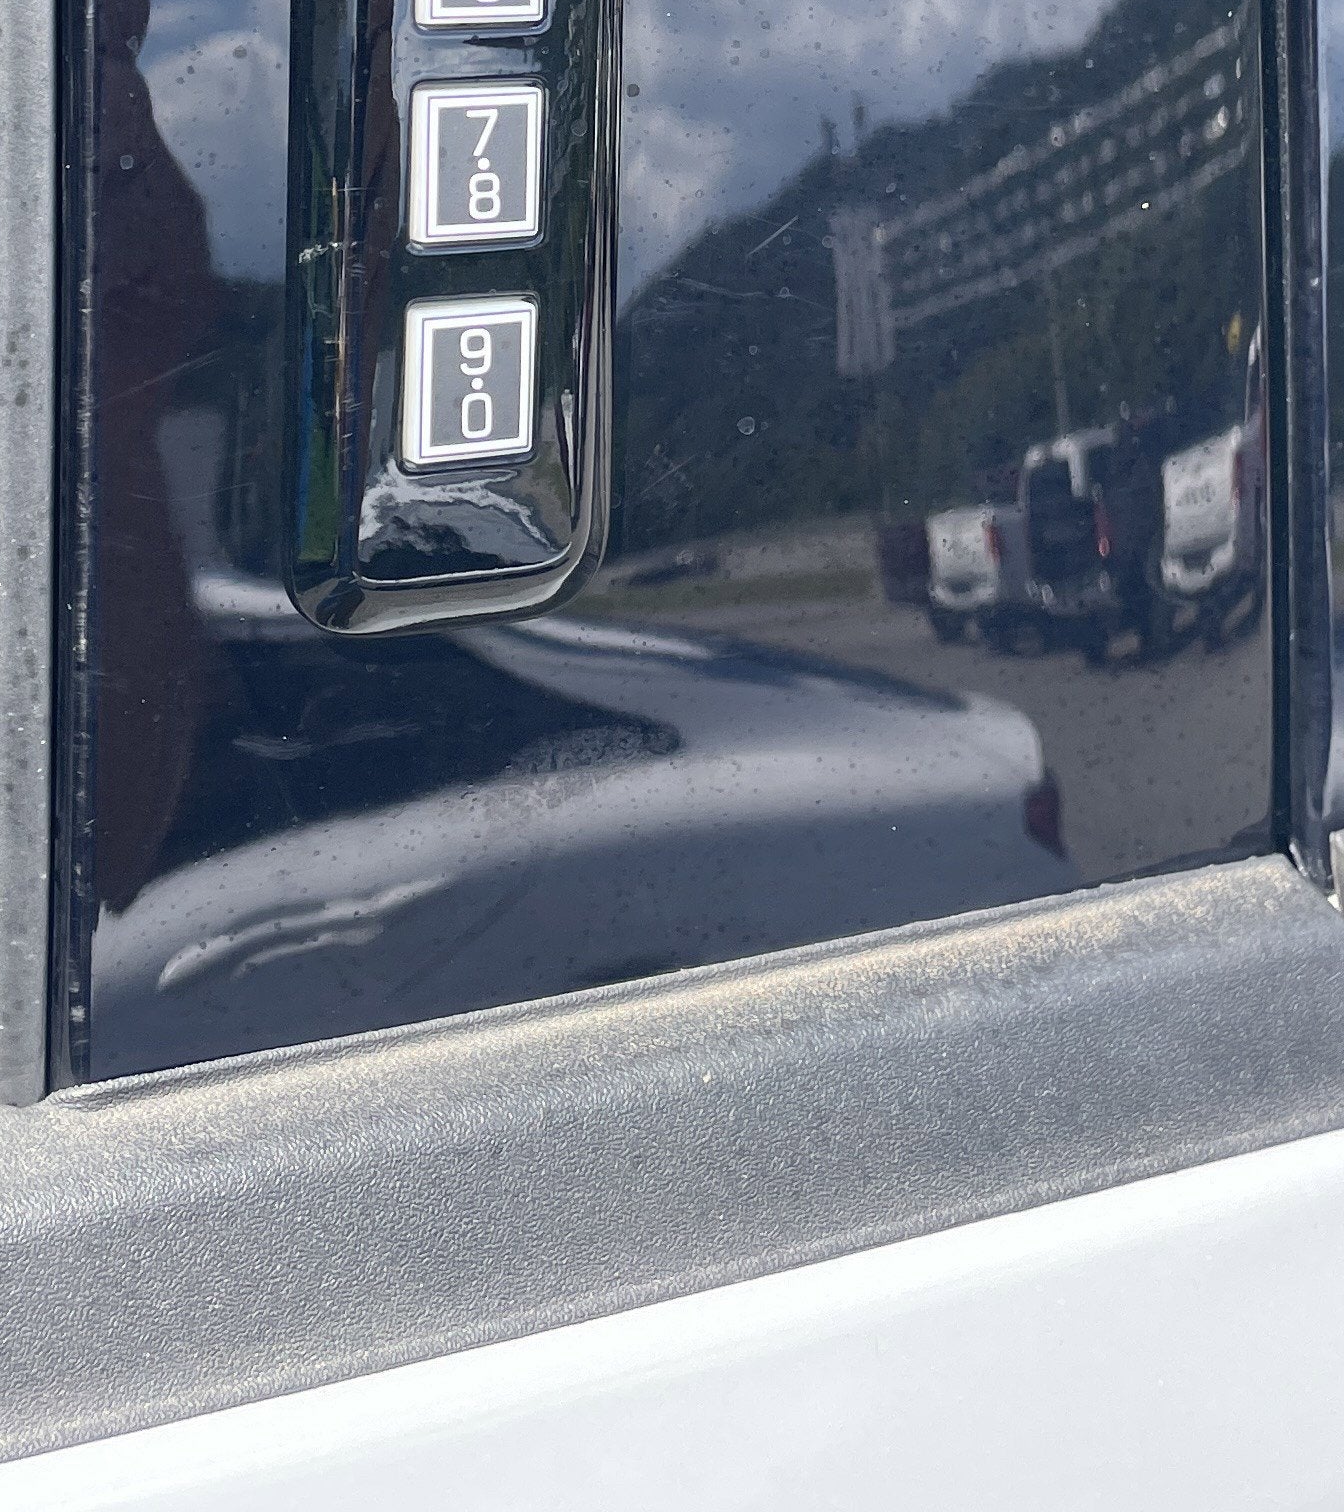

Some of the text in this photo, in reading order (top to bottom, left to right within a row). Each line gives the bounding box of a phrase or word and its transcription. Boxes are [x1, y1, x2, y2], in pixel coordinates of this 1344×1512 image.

[465, 108, 499, 157] 7
[468, 172, 501, 221] 8
[459, 328, 492, 376] 9
[461, 392, 493, 439] 0
